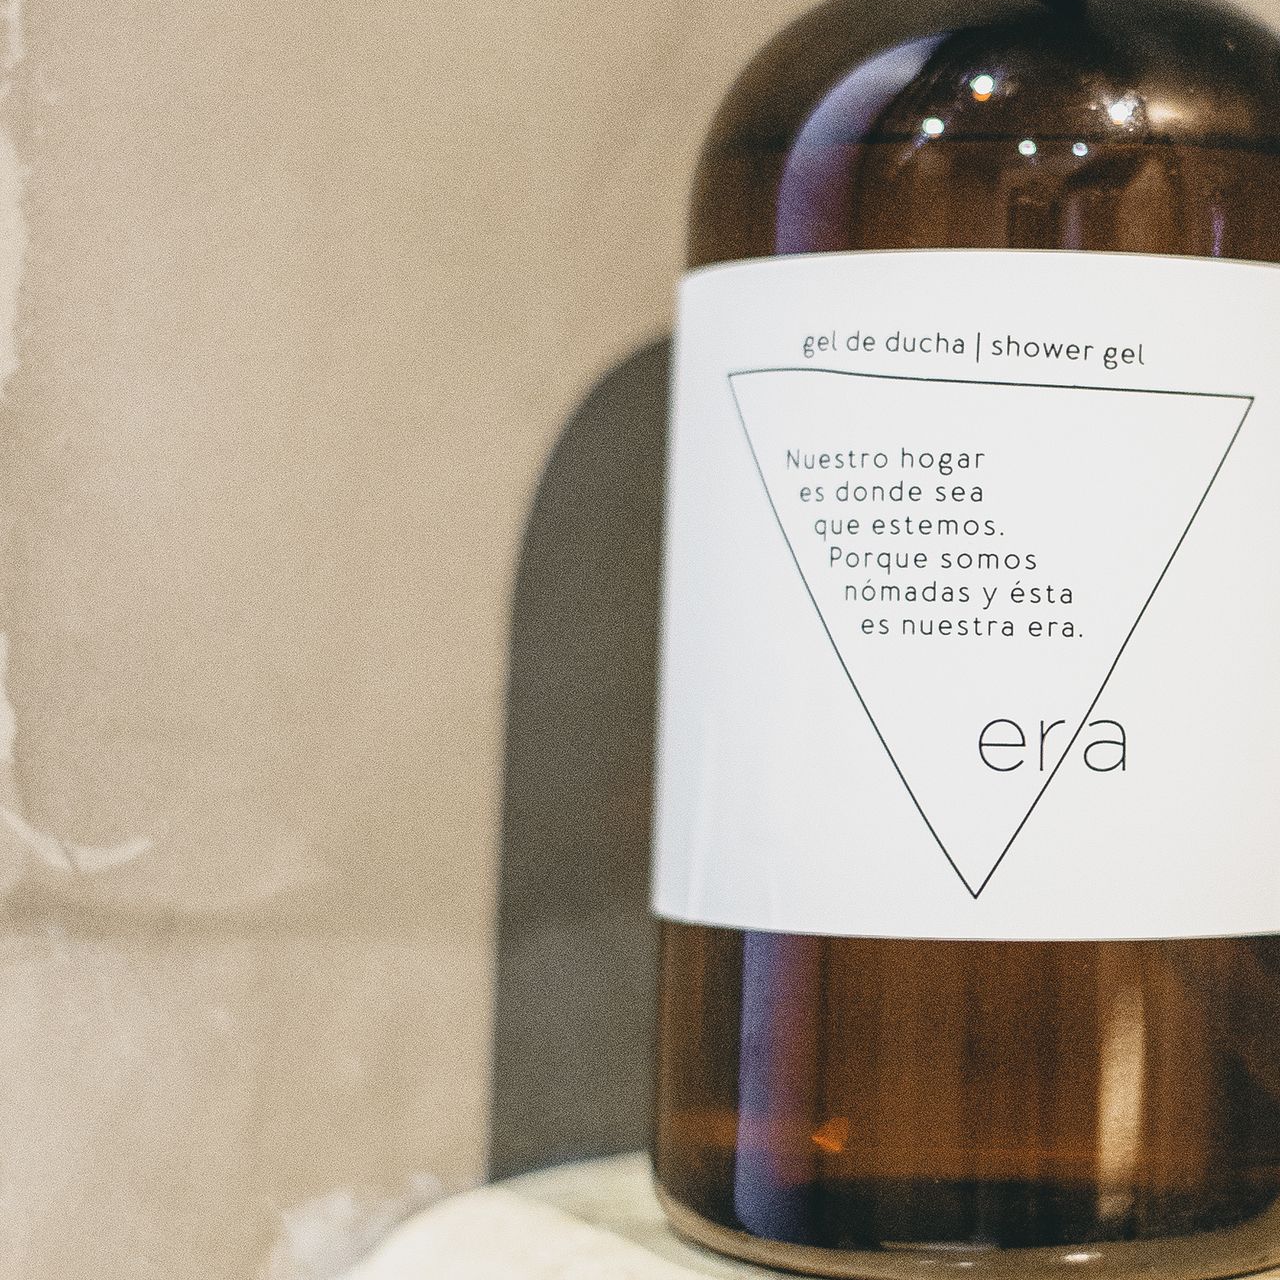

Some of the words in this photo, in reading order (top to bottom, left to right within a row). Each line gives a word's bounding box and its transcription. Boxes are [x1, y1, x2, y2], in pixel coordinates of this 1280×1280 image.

[802, 331, 836, 359] gel
[845, 332, 876, 353] de
[884, 331, 966, 355] ducha
[991, 335, 1094, 362] shower
[1102, 344, 1145, 370] gel
[786, 449, 889, 470] Nuestro
[900, 448, 984, 477] hogar
[798, 485, 825, 503] es
[835, 481, 923, 503] donde
[935, 485, 984, 504] sea
[813, 518, 861, 542] que
[870, 516, 1007, 537] estemos.
[828, 545, 929, 574] Porque
[940, 551, 1038, 571] somos
[844, 579, 971, 604] nómadas
[982, 587, 998, 613] y
[1009, 579, 1074, 605] ésta
[860, 617, 890, 636] es
[901, 617, 1015, 638] nuestra
[1027, 620, 1086, 639] era.
[977, 715, 1128, 772] era
